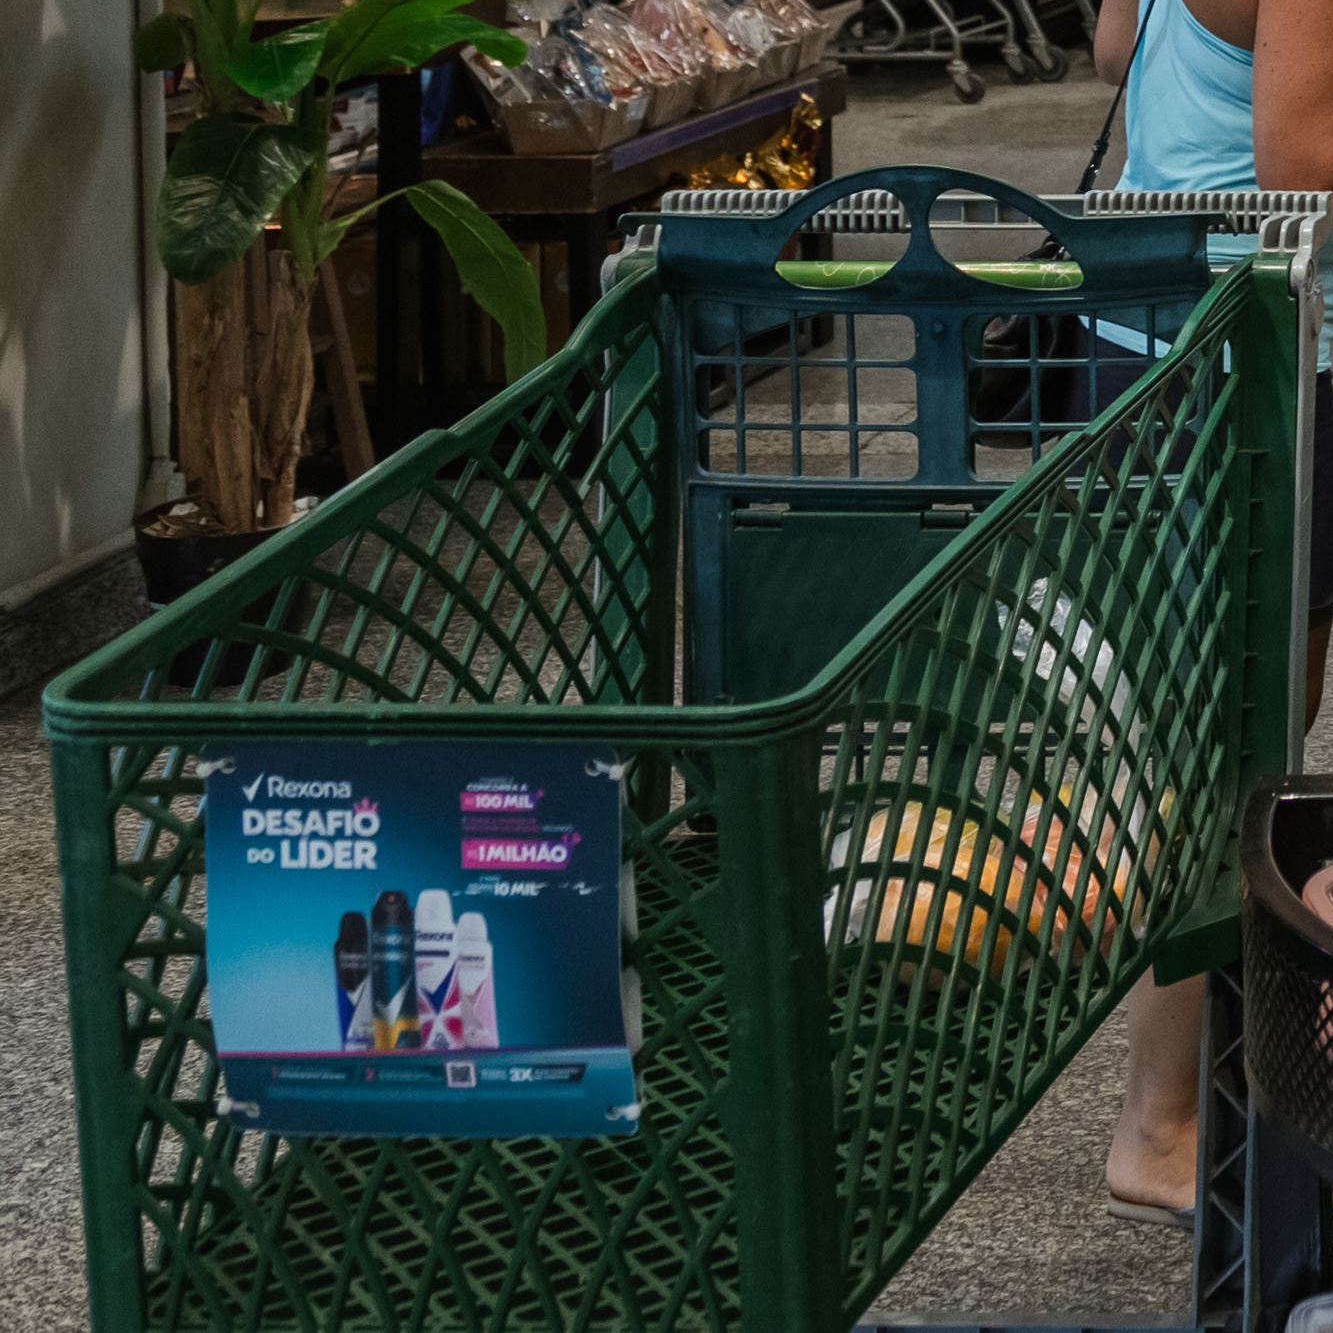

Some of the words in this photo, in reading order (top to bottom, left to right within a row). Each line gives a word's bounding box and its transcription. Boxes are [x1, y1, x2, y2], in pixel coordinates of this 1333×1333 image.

[267, 774, 351, 801] Rexona
[475, 795, 502, 808] 100
[503, 794, 533, 808] MIL
[242, 808, 381, 837] DESAFIO
[247, 847, 276, 865] DO
[280, 836, 378, 870] LÍDER
[486, 841, 568, 863] MILHÃO
